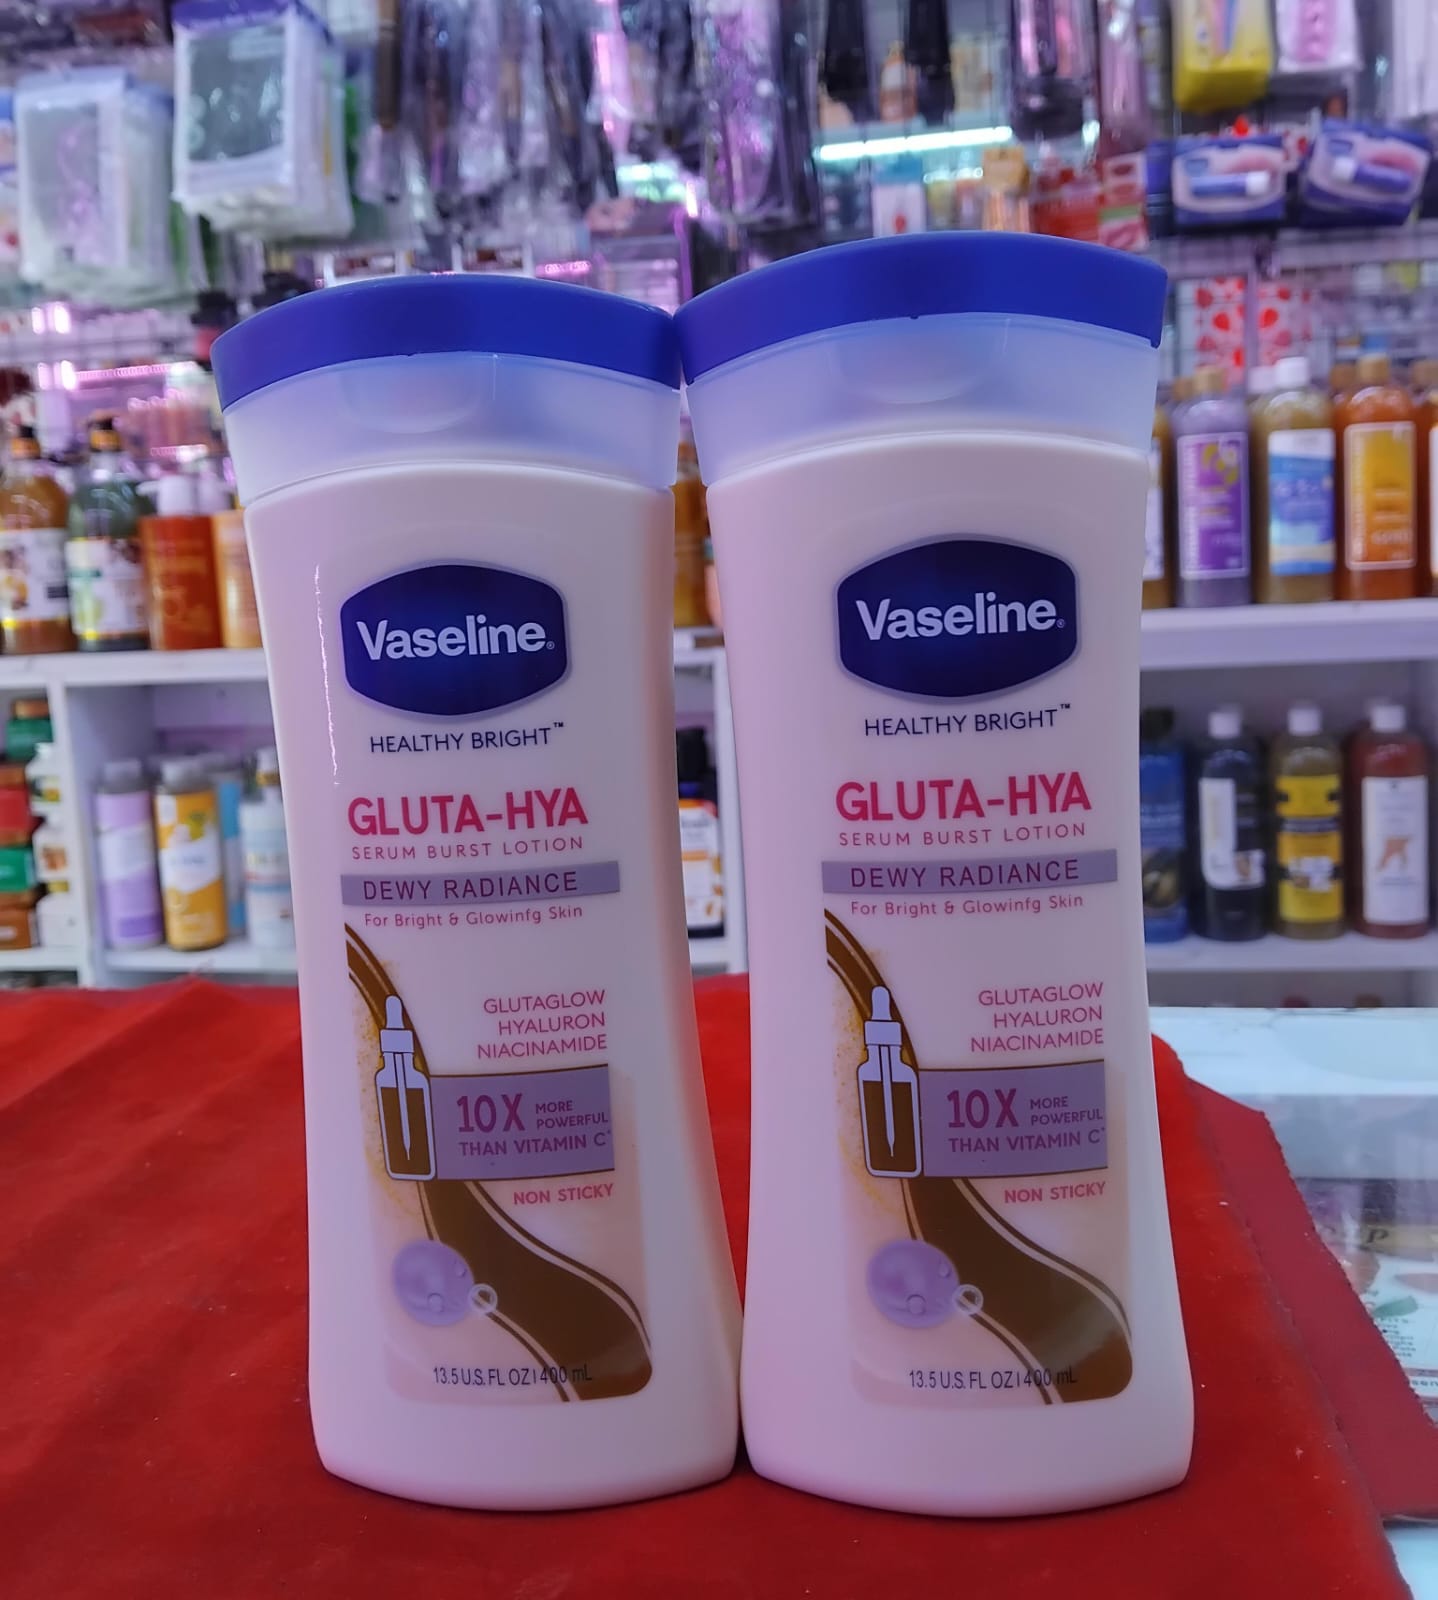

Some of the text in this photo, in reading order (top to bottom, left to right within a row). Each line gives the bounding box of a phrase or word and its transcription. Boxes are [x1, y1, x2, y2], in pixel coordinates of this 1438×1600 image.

[865, 715, 967, 737] HEALTHY
[370, 733, 464, 753] HEALTHY
[836, 771, 1092, 821] GLUTA-HYA
[348, 787, 588, 835] GLUTA-HYA
[839, 823, 1086, 846] SERUM BURST LOTION
[352, 836, 583, 860] SERUM BURST LOTION
[851, 859, 1079, 888] DEWY RADIANCE
[364, 871, 578, 900] DEWY RADIANCE
[364, 905, 583, 930] For Bright & Glowinfg Skin
[851, 895, 1083, 918] For Bright & Glowinfg Skin
[483, 989, 606, 1014] GLUTAGLOW
[978, 982, 1103, 1006] GLUTAGLOW
[498, 1012, 605, 1035] HYALURON
[993, 1005, 1102, 1029] HYALURON
[477, 1034, 608, 1059] NIACINAMIDE
[971, 1028, 1104, 1053] NIACINAMIDE
[456, 1093, 526, 1133] 10X
[535, 1100, 573, 1115] MORE
[947, 1088, 1019, 1129] 10X
[1029, 1096, 1068, 1110] MORE
[536, 1112, 609, 1130] POWERFUL
[1031, 1108, 1103, 1126] POWERFUL
[458, 1140, 507, 1156] THAN
[513, 1133, 587, 1154] VITAMIN
[948, 1137, 999, 1152] THAN
[1006, 1131, 1081, 1150] VITAMIN
[513, 1183, 613, 1205] NON STICKY
[1004, 1181, 1106, 1203] NON STICKY
